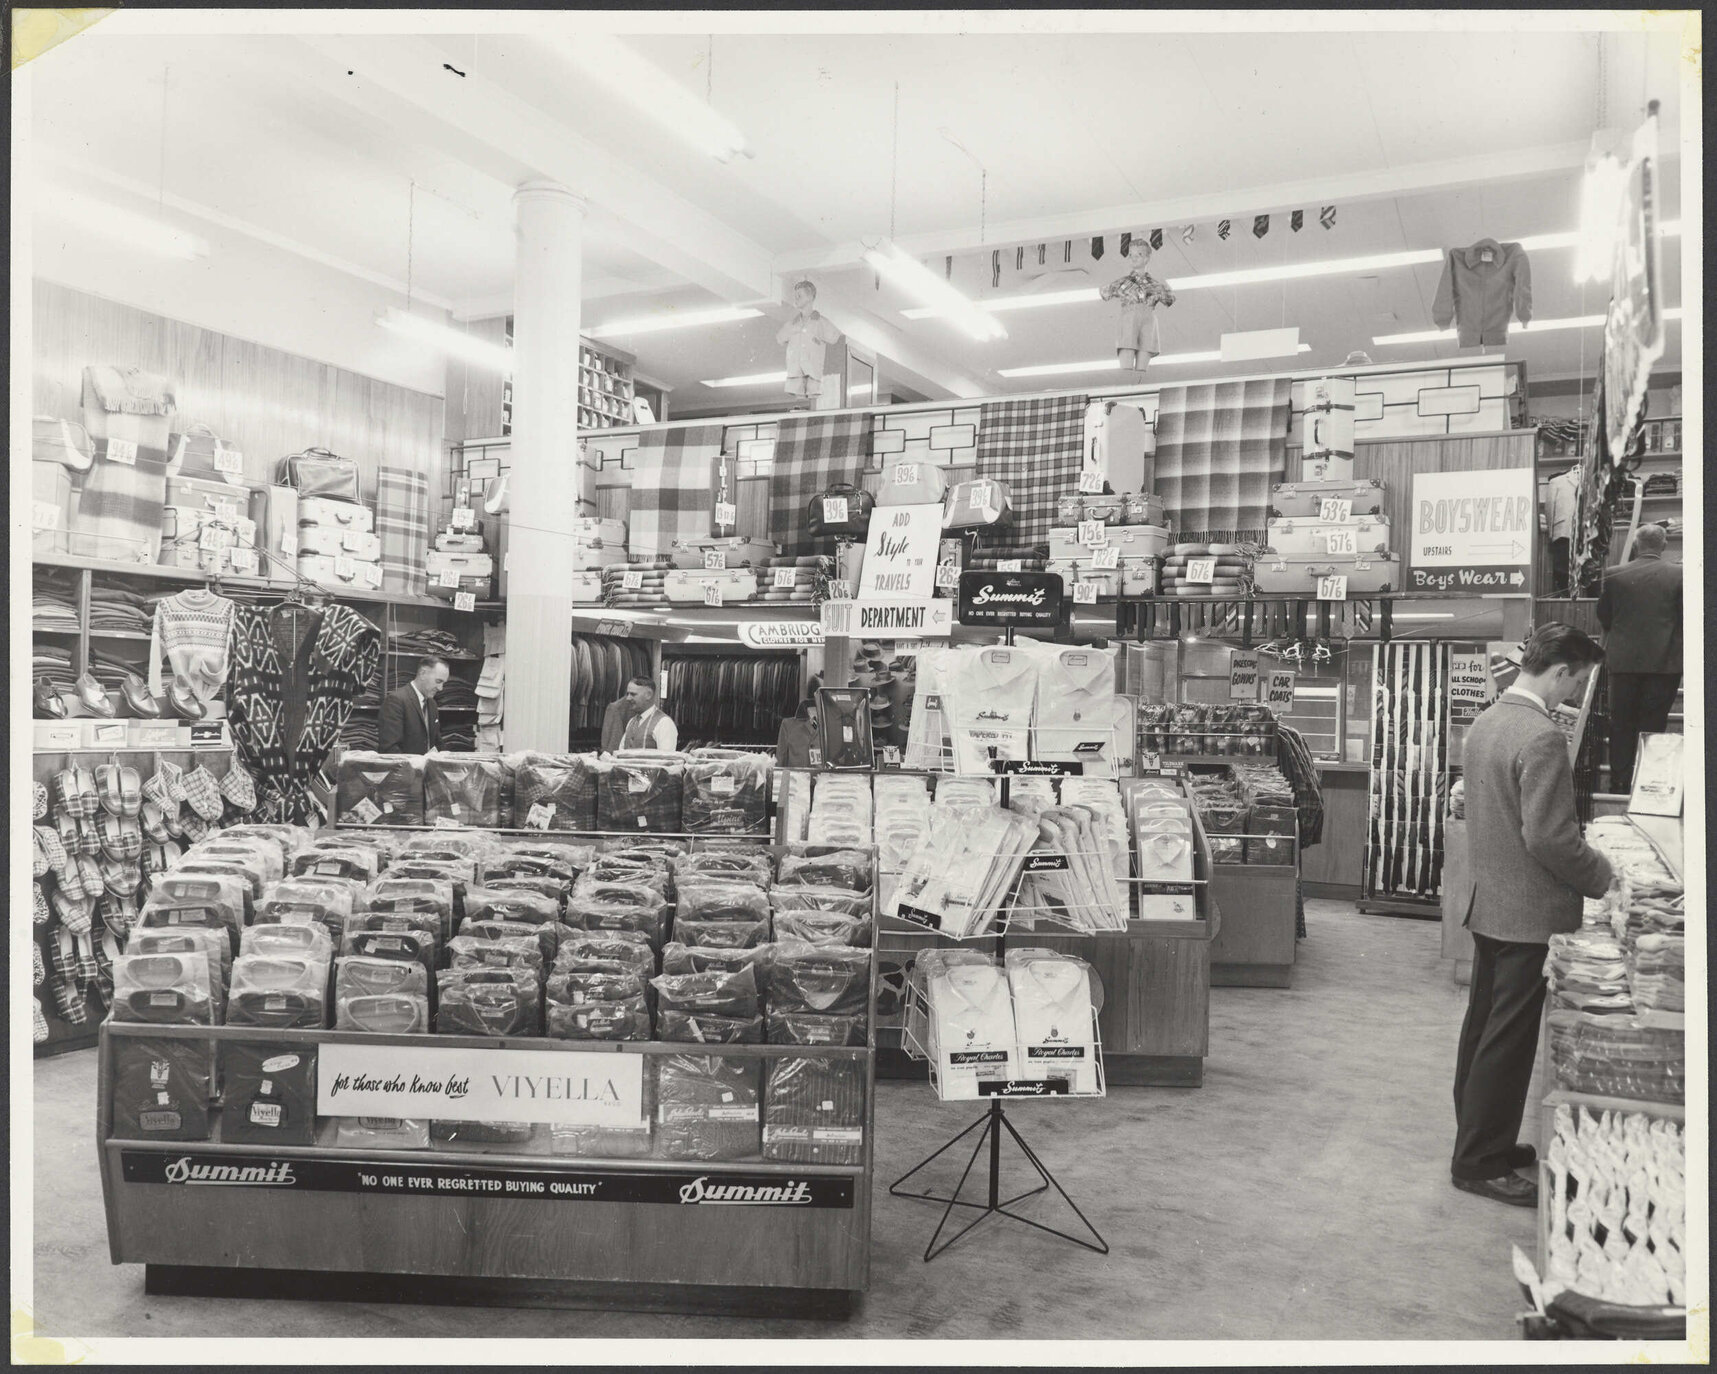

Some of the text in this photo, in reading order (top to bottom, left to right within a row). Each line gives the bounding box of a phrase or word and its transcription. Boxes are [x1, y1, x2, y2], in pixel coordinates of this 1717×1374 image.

[892, 512, 911, 527] ADD
[1419, 496, 1530, 534] BOYSWEAR
[874, 531, 910, 562] Style
[1423, 546, 1452, 557] UPSTAIRS
[875, 573, 911, 591] TRAVELS
[1413, 569, 1508, 590] Boys Wear
[972, 584, 1046, 606] Summit
[824, 603, 926, 632] SUIT DEPARTMENT
[748, 623, 820, 645] CAMBRIDG
[1468, 660, 1483, 672] for
[1231, 672, 1257, 686] GOWNS
[1273, 676, 1291, 688] CAR
[1269, 690, 1292, 703] COATS
[1451, 688, 1485, 698] CLOTHES
[1017, 761, 1060, 773] Summit
[956, 1052, 1004, 1063] Royal Charles
[1033, 1047, 1080, 1058] Royal Charles
[331, 1073, 350, 1097] for
[352, 1073, 382, 1092] those
[382, 1074, 406, 1092] who
[445, 1073, 470, 1096] best
[491, 1075, 620, 1101] VIYELLA
[1001, 1080, 1046, 1094] Summit
[165, 1157, 296, 1185] Summit
[382, 1176, 404, 1188] ONE
[408, 1177, 434, 1190] EVER
[437, 1178, 502, 1192] REGRETTED
[505, 1180, 545, 1193] BUYING
[679, 1176, 812, 1205] Summit
